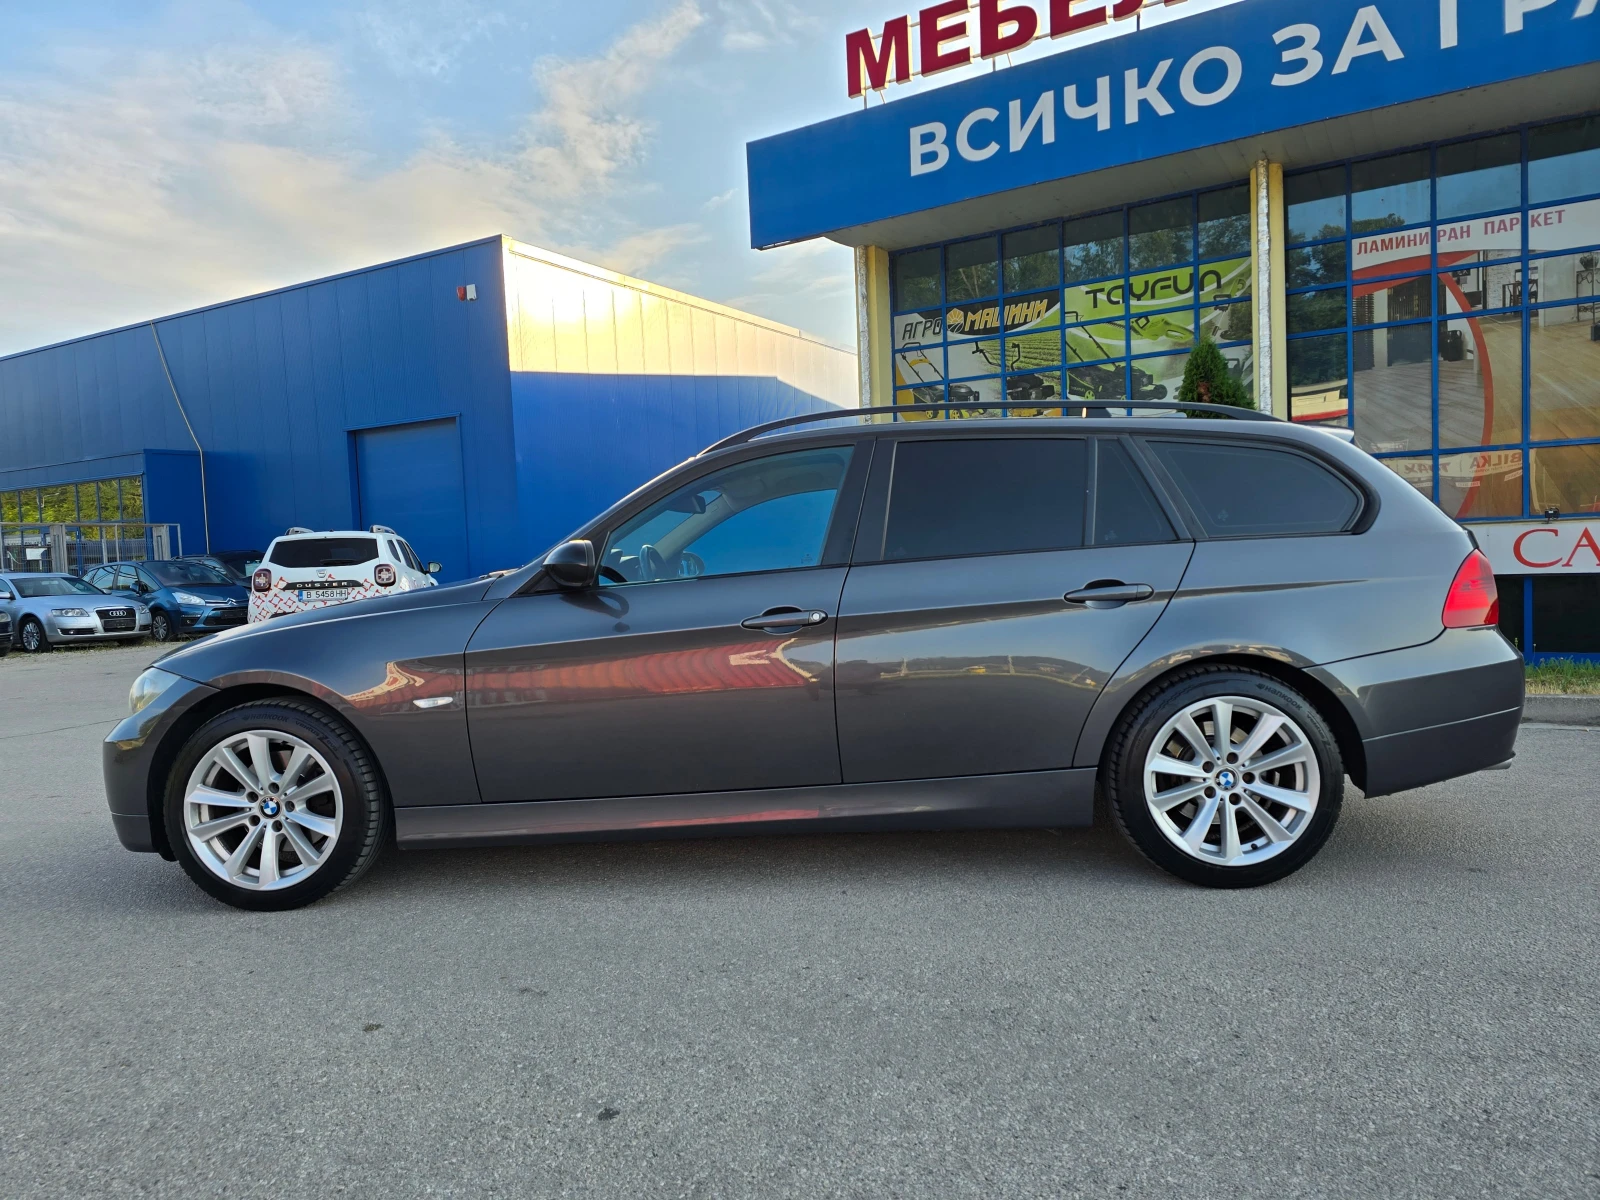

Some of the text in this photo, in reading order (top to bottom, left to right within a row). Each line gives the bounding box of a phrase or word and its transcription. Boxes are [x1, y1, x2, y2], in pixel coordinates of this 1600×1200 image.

[908, 46, 1243, 178] ВСИЧКО
[1270, 4, 1405, 88] ЗА
[902, 298, 1048, 341] АГРО МАШИНИ
